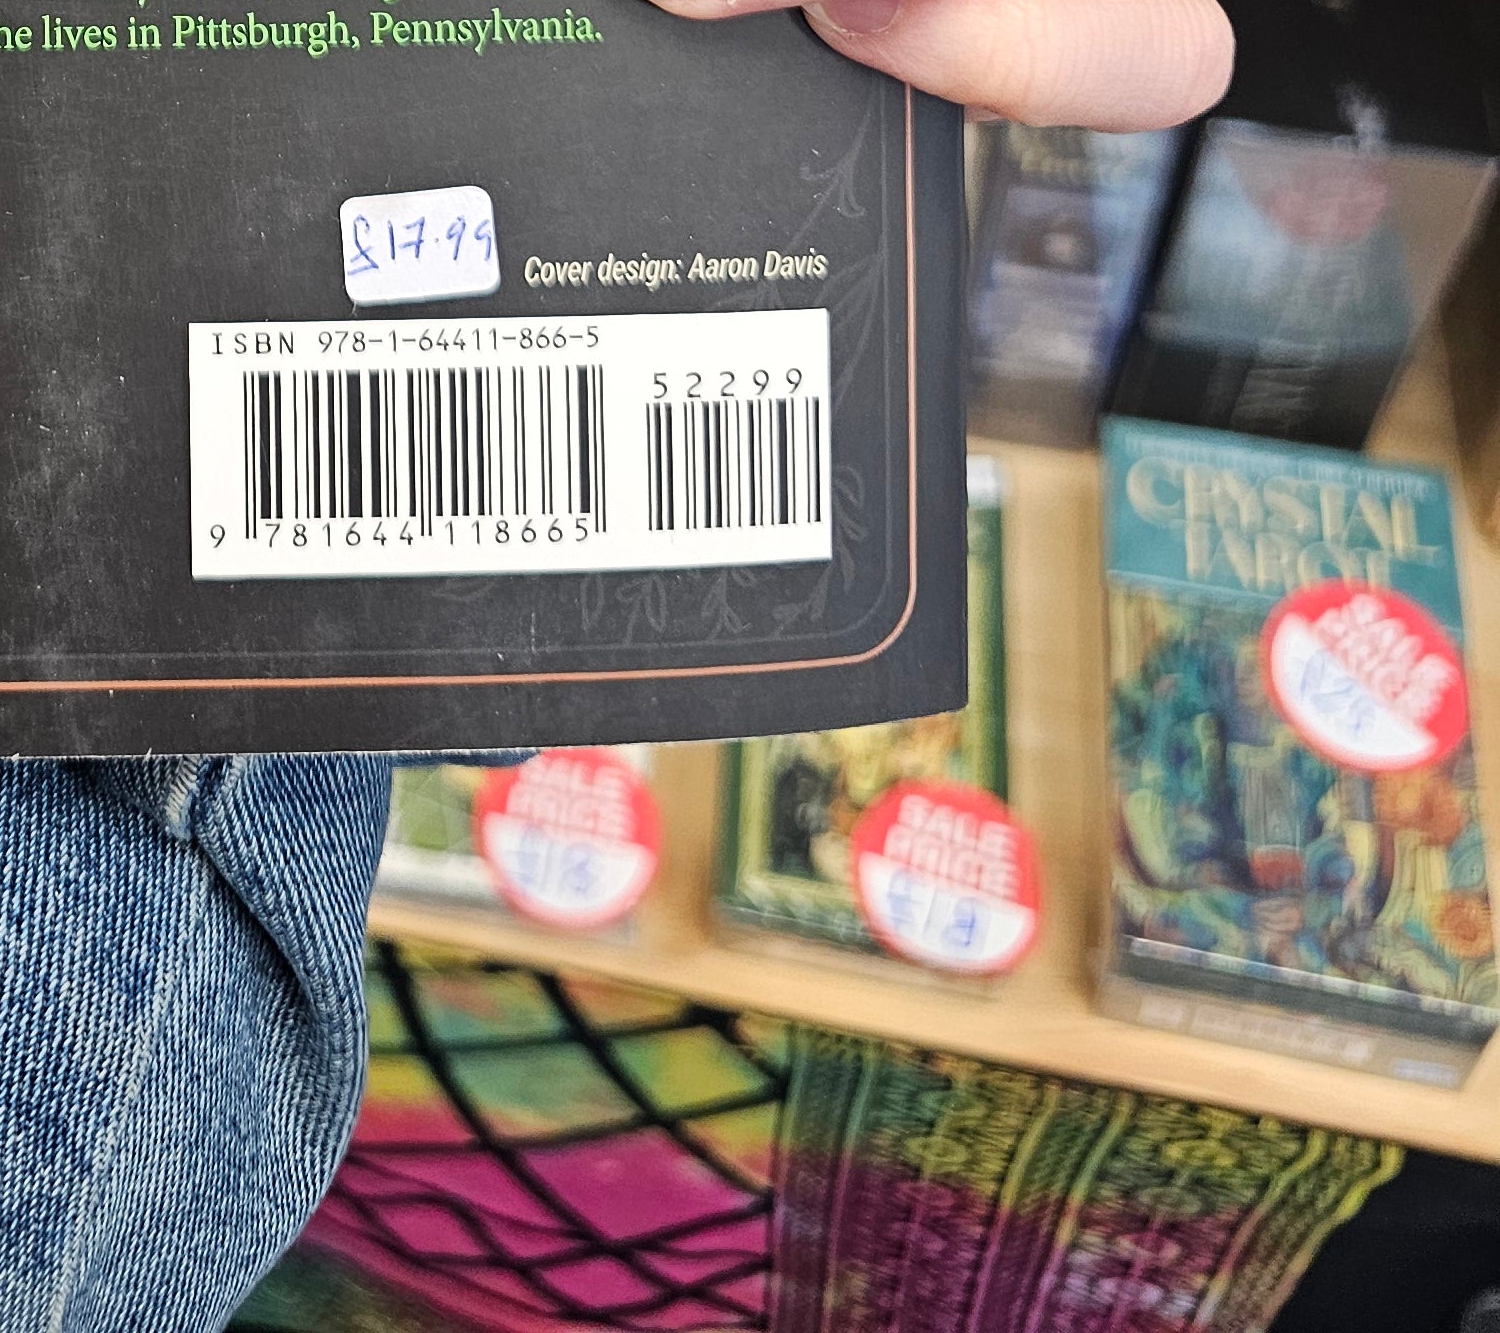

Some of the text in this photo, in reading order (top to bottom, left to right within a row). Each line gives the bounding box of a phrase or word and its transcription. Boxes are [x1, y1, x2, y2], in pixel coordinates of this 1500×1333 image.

[42, 15, 117, 51] lives
[128, 17, 161, 50] in
[172, 11, 360, 58] Pittsburgh,
[370, 8, 603, 55] Pennsylvania.
[347, 213, 493, 276] £17.99
[523, 247, 828, 289] Cover design: Aaron Davis
[211, 325, 600, 355] ISBN 978-1-64411-866-5
[1126, 454, 1443, 567] CRYSTAL
[520, 755, 634, 801] SALE
[897, 792, 1021, 851] SALE
